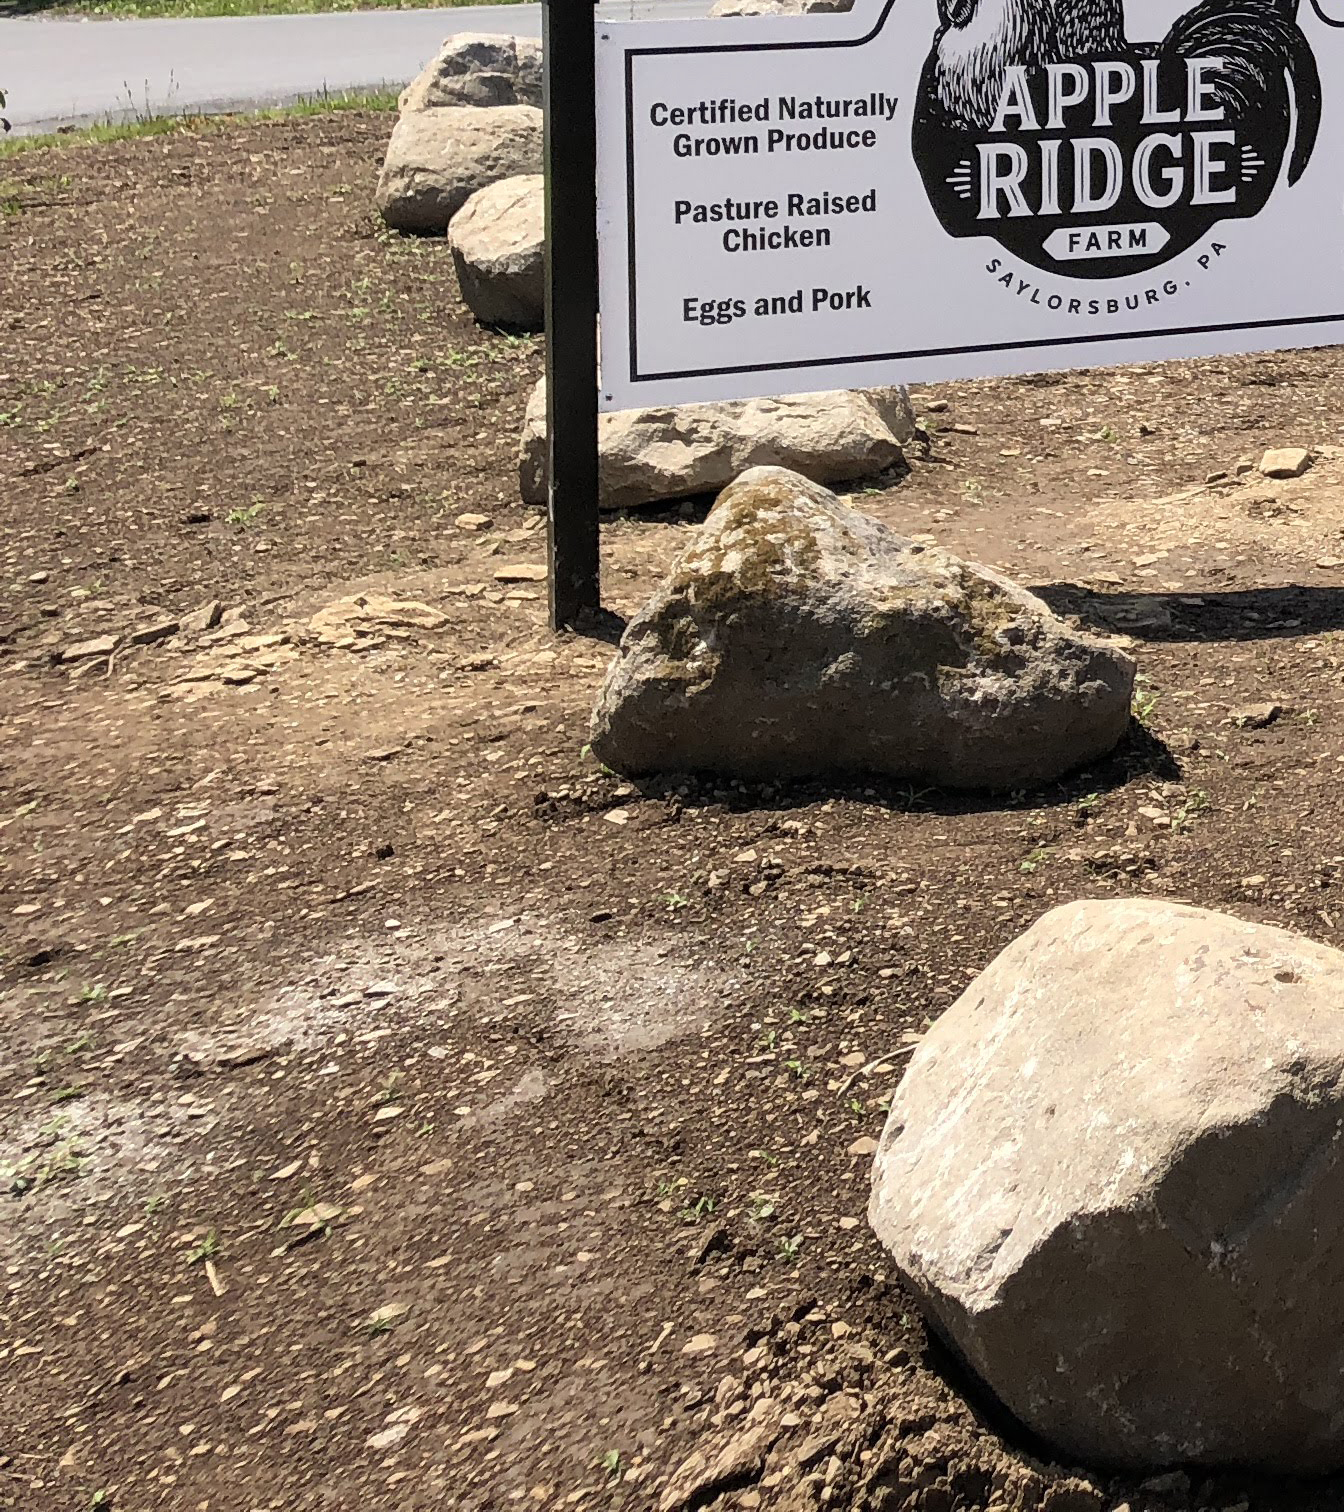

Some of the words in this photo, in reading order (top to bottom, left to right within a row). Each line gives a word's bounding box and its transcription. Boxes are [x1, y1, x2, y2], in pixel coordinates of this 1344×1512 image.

[650, 98, 770, 126] Certified
[778, 93, 899, 121] Naturally
[988, 58, 1226, 132] APPLE
[673, 133, 759, 157] Grown
[767, 127, 877, 152] Produce
[975, 130, 1237, 220] RIDGE
[674, 198, 779, 224] Pasture
[787, 189, 877, 217] Raised
[723, 226, 831, 252] Chicken
[1068, 228, 1148, 253] FARM
[1197, 241, 1227, 270] PA
[683, 297, 747, 326] Eggs
[754, 290, 803, 316] and
[812, 285, 872, 312] Pork
